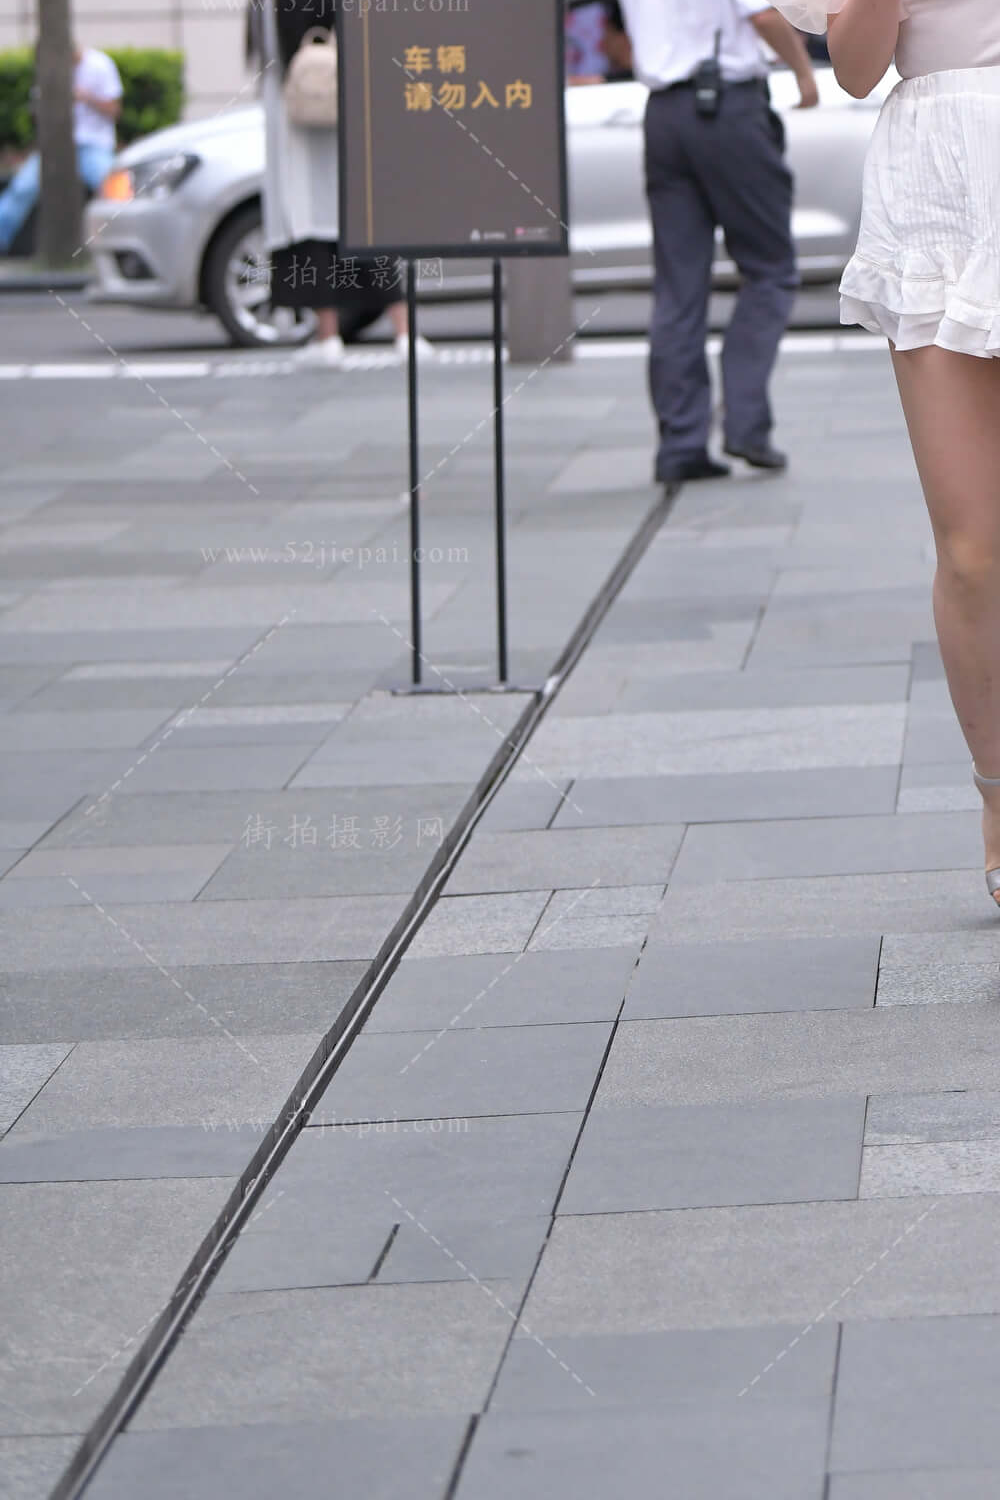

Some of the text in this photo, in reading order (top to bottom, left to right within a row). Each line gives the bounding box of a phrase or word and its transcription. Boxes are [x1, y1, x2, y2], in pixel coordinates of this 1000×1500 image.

[404, 45, 466, 74] 车辆
[404, 80, 532, 111] 请勿入内
